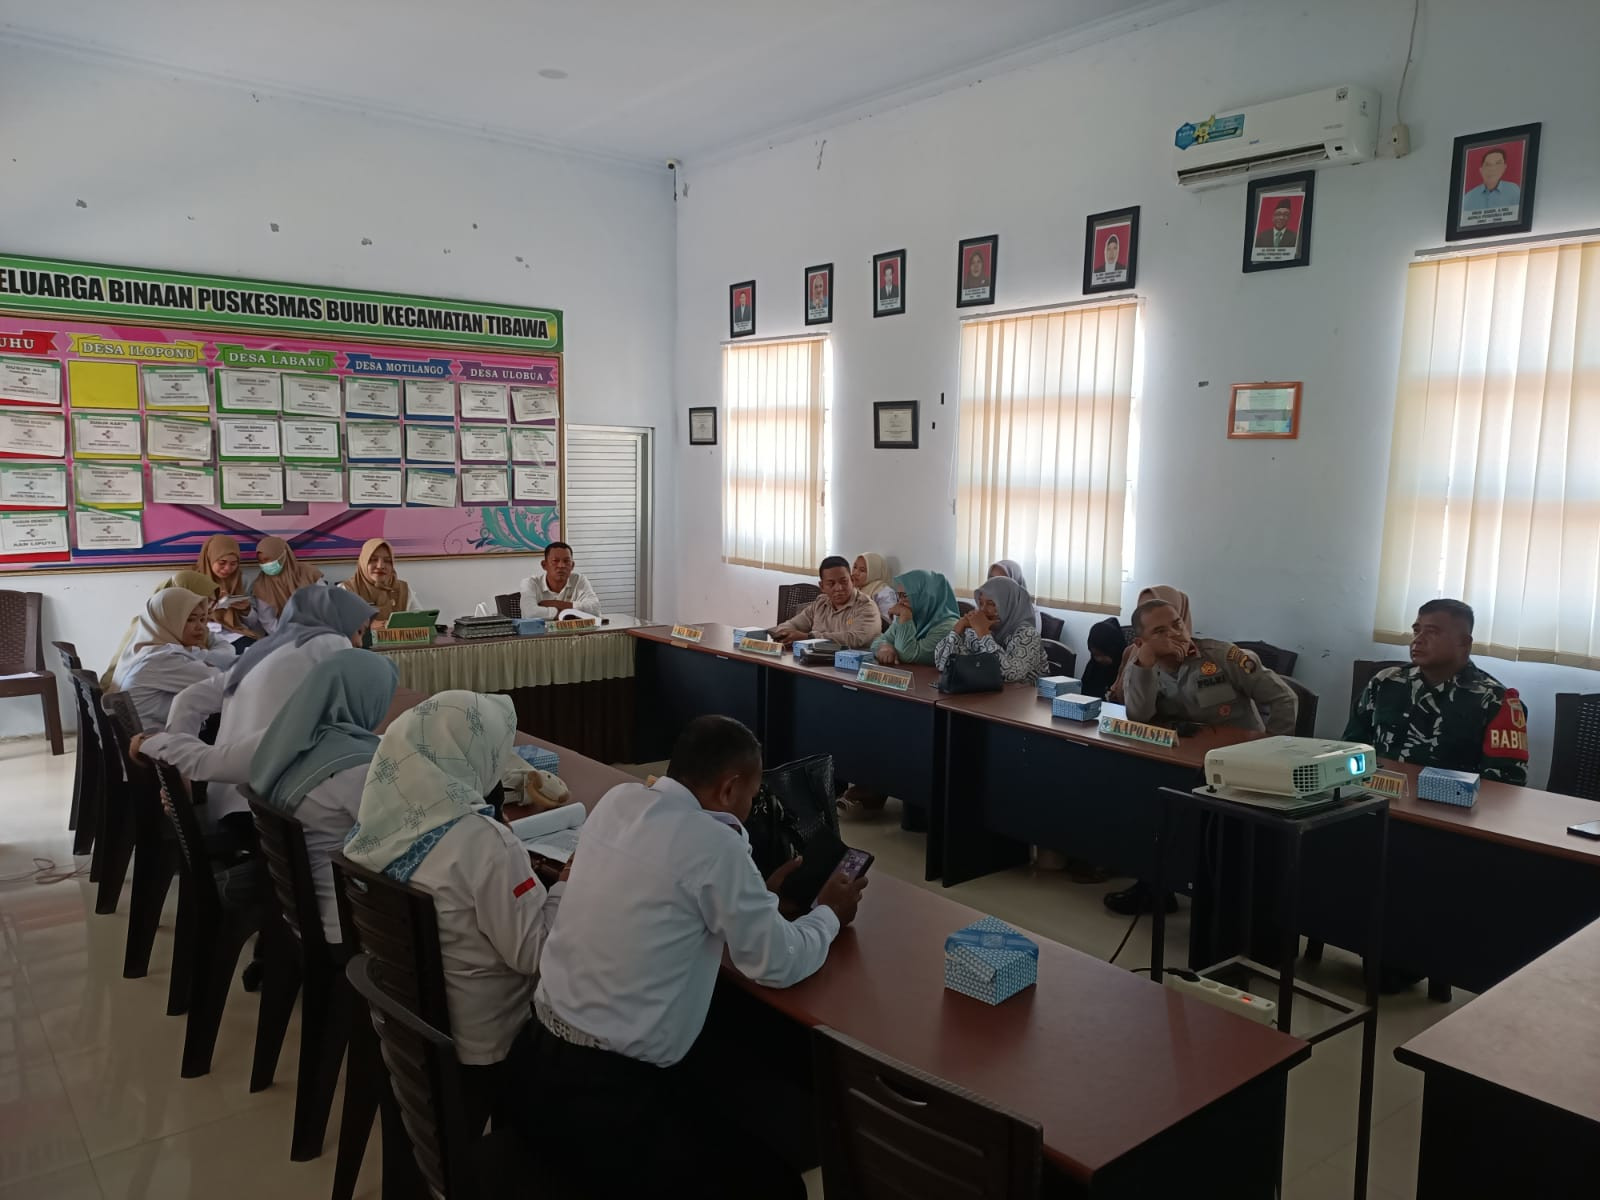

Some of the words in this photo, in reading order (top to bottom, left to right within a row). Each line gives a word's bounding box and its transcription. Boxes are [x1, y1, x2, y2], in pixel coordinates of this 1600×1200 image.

[0, 268, 104, 301] ELUARGA
[108, 279, 193, 309] BINAAN
[198, 289, 323, 320] PUSKESMAS
[327, 299, 378, 325] BUHU
[383, 304, 482, 334] KECAMATAN
[486, 314, 548, 339] TIBAWA
[83, 342, 124, 356] DESA
[129, 345, 196, 360] ILOPONU
[229, 352, 267, 365] DESA
[271, 354, 326, 368] LABANU
[355, 360, 383, 372] DESA
[386, 363, 444, 375] MOTILANGO
[470, 368, 498, 379] DESA
[502, 370, 544, 381] ULOBUA
[1113, 720, 1173, 745] KAPOLSEK
